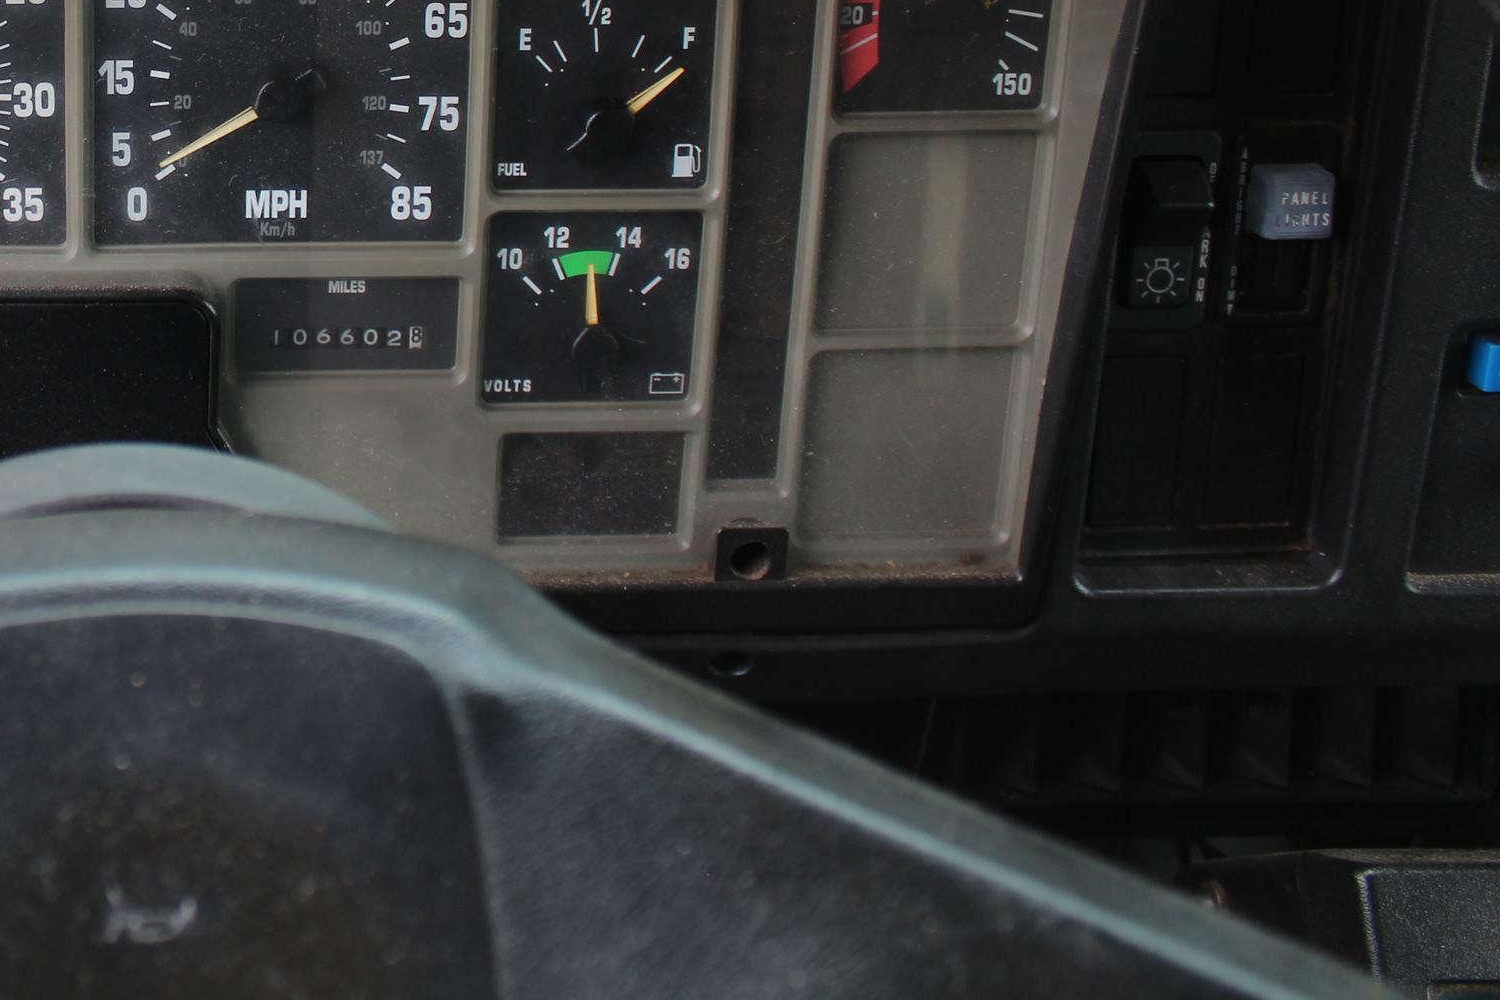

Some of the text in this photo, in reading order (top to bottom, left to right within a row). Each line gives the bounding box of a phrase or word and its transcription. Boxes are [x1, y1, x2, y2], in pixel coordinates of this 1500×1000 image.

[424, 2, 468, 39] 65
[841, 5, 864, 25] 20
[179, 21, 197, 37] 40
[356, 20, 382, 36] 100
[519, 28, 532, 51] E
[683, 26, 696, 50] F
[99, 59, 135, 96] 15
[992, 72, 1033, 96] 150
[12, 82, 56, 118] 30
[174, 95, 192, 110] 20
[361, 96, 387, 111] 120
[418, 95, 460, 132] 75
[111, 132, 132, 167] 5
[359, 150, 384, 165] 137
[498, 162, 527, 176] FUEL
[2, 187, 45, 222] 35
[127, 186, 148, 222] 0
[245, 189, 308, 219] MPH
[390, 185, 433, 221] 85
[1281, 191, 1329, 206] PANEL
[259, 221, 296, 238] Km/h
[1276, 212, 1331, 227] IGHTS
[543, 226, 570, 249] 12
[616, 226, 642, 249] 14
[497, 248, 523, 270] 10
[664, 247, 691, 270] 16
[328, 280, 367, 293] MILES
[1195, 277, 1205, 303] ON
[484, 378, 532, 393] VOLTS
